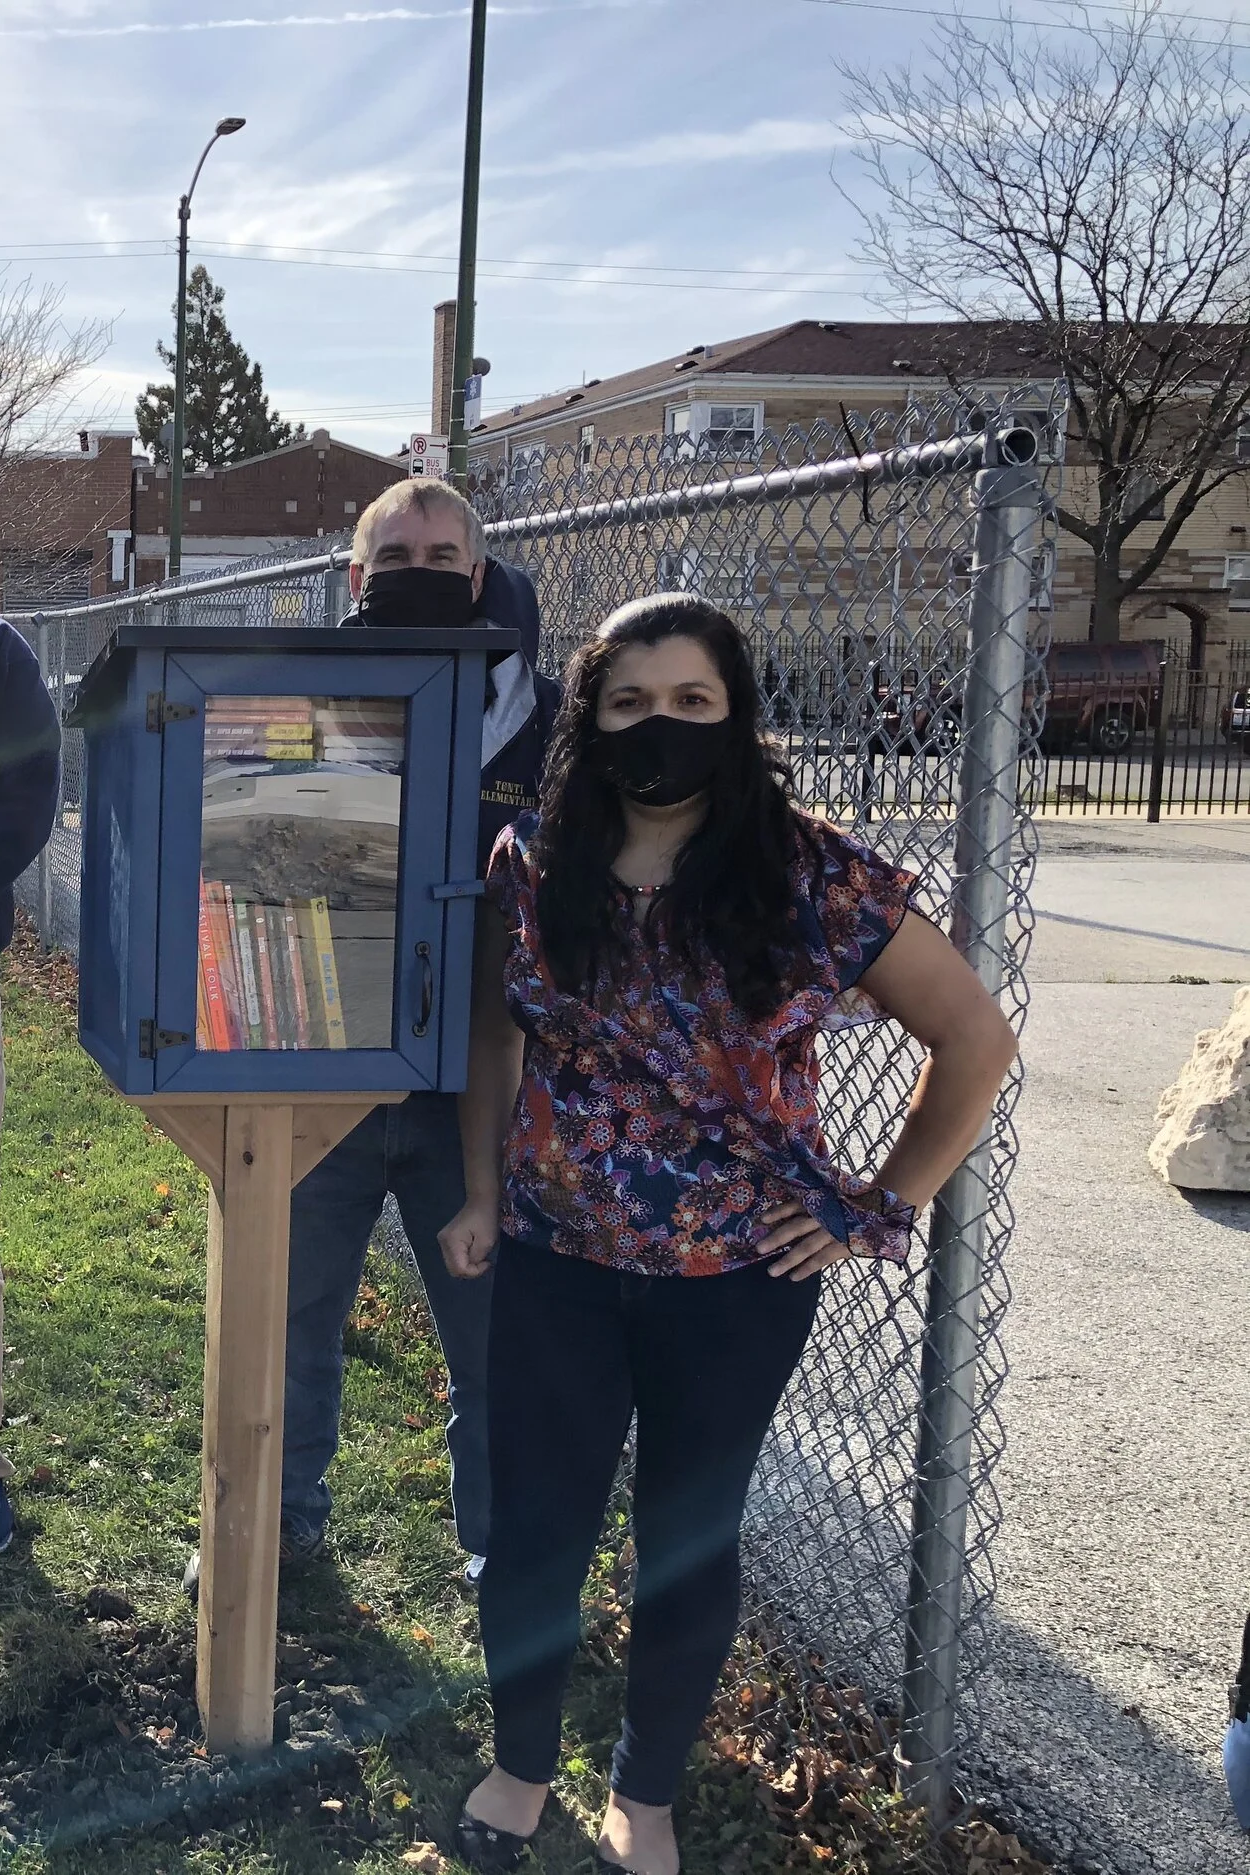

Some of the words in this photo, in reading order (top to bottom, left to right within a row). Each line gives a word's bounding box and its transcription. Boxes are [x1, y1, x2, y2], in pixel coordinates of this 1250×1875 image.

[426, 459, 439, 467] BUS
[426, 468, 442, 476] STOP
[495, 780, 524, 794] TONTI
[206, 967, 219, 1001] FOLK
